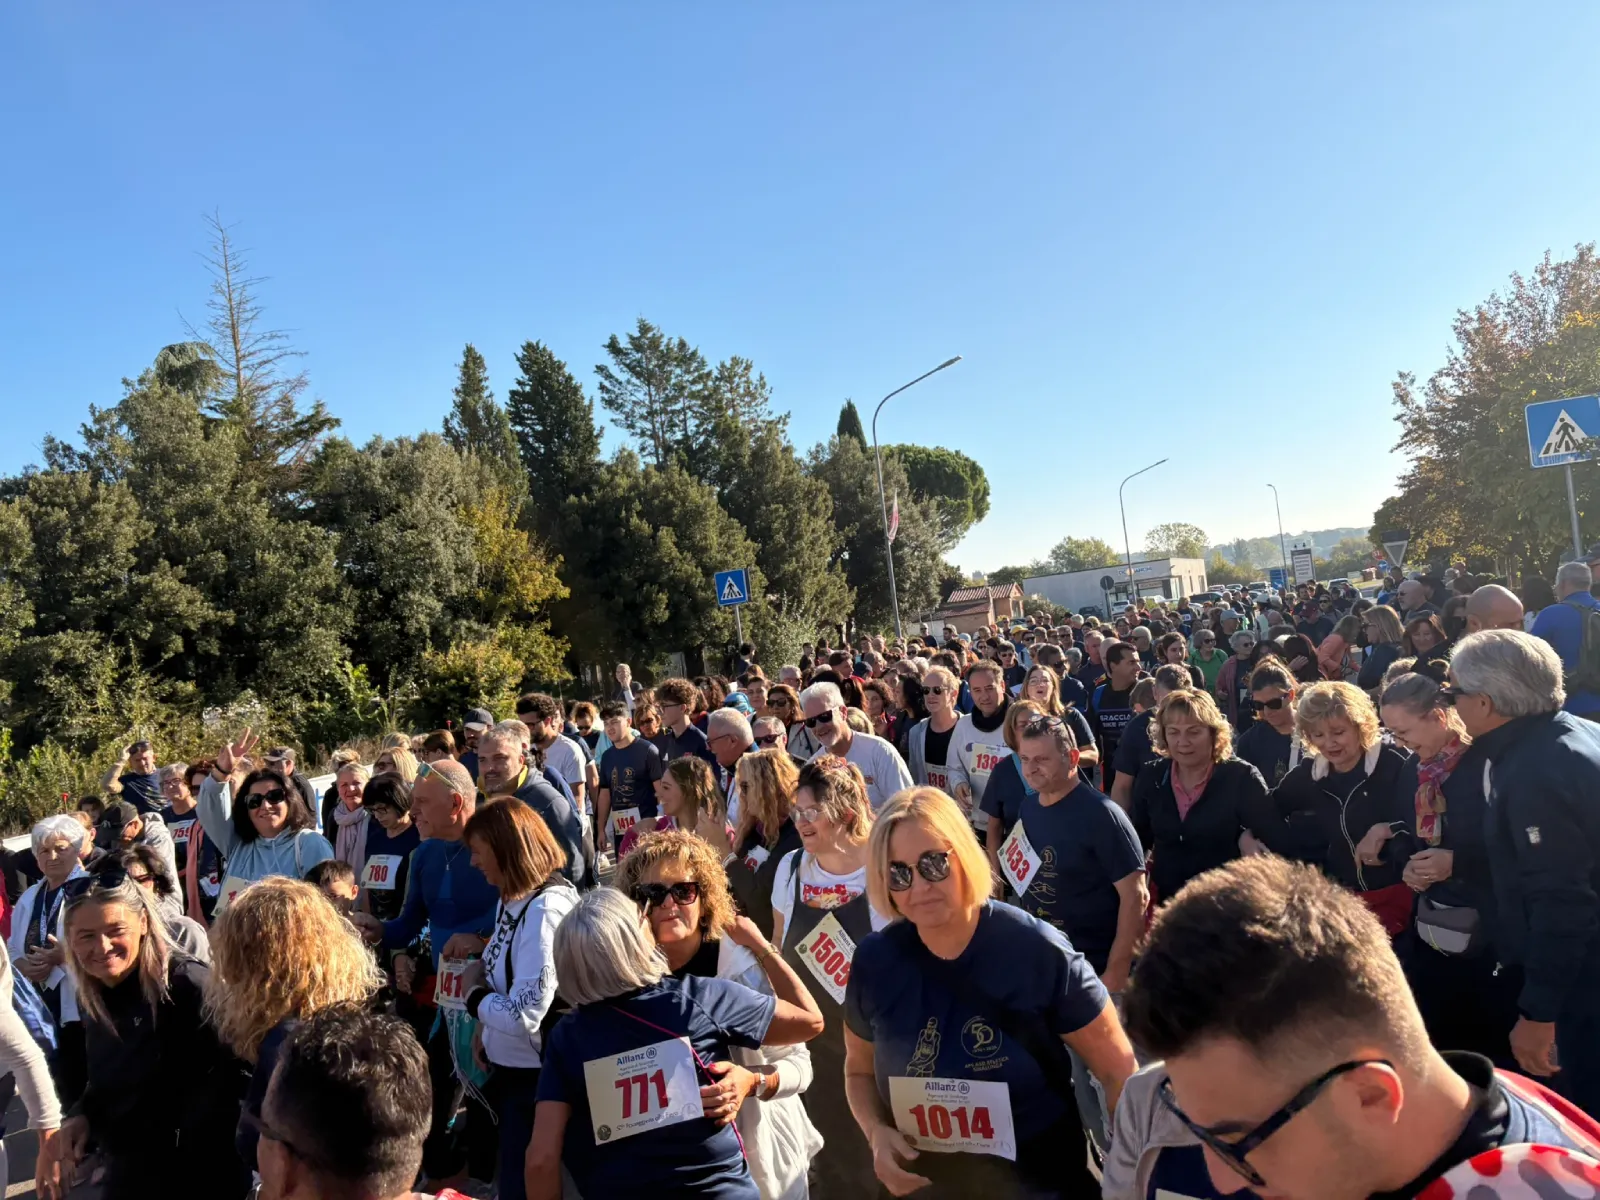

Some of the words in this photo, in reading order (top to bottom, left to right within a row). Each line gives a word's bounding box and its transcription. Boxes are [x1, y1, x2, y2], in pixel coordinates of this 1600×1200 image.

[976, 753, 1005, 771] 138
[927, 772, 948, 789] 138
[1005, 836, 1031, 881] 1433
[368, 864, 389, 882] 780
[809, 931, 851, 987] 1505
[440, 970, 464, 998] 141
[617, 1053, 646, 1066] Allianz
[614, 1068, 669, 1119] 771
[925, 1081, 957, 1092] Allianz
[909, 1104, 994, 1139] 1014
